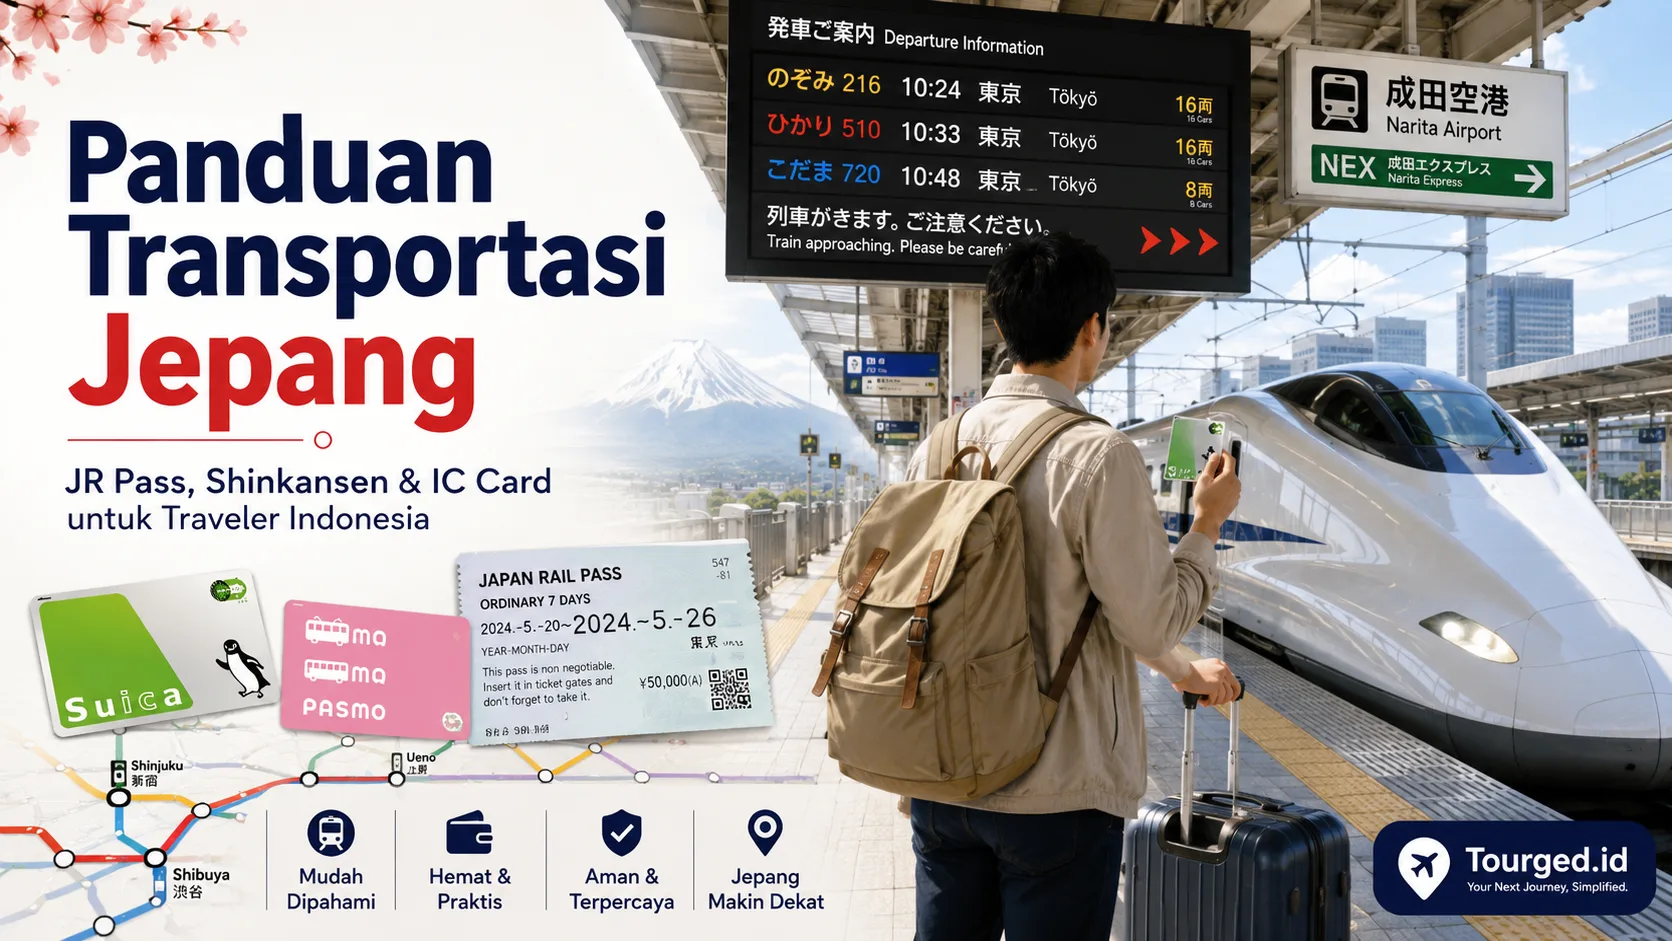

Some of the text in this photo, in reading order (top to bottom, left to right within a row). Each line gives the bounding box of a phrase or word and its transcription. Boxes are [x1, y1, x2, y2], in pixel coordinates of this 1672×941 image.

[768, 16, 1043, 55] 発車ご案内 Departure Information
[768, 68, 834, 91] のぞみ
[843, 73, 880, 94] 216
[903, 77, 961, 99] 10:24
[979, 81, 1021, 104] 東京
[1386, 75, 1509, 117] 成田空港
[1176, 96, 1213, 114] 16両
[768, 114, 831, 137] ひかり
[843, 119, 880, 139] 510
[902, 122, 960, 143] 10:33
[979, 125, 1021, 148] 東京
[1387, 116, 1501, 143] Narita Airport
[1176, 138, 1213, 156] 16両
[1321, 153, 1376, 179] NEX
[1388, 155, 1491, 175] 成田エクスプレス
[768, 159, 832, 182] こだま
[842, 164, 880, 184] 720
[902, 166, 960, 187] 10:48
[979, 169, 1021, 192] 東京
[1388, 173, 1462, 187] Narita Express
[1186, 181, 1212, 198] 8両
[767, 234, 801, 248] Train
[806, 238, 894, 255] approaching.
[901, 239, 943, 254] Please
[948, 241, 964, 255] be
[712, 558, 729, 567] 547
[479, 567, 622, 587] JAPAN RAIL PASS
[480, 593, 590, 610] ORDINARY 7 DAYS
[481, 643, 569, 656] YEAR-MONTH-DAY
[482, 667, 502, 676] This
[506, 668, 527, 677] pass
[531, 665, 538, 674] is
[563, 661, 615, 674] negotiable.
[484, 675, 612, 691] Insert it in ticket gates and
[65, 687, 182, 722] Suica
[303, 698, 385, 720] PASMO
[484, 691, 590, 707] don't forget to take it.
